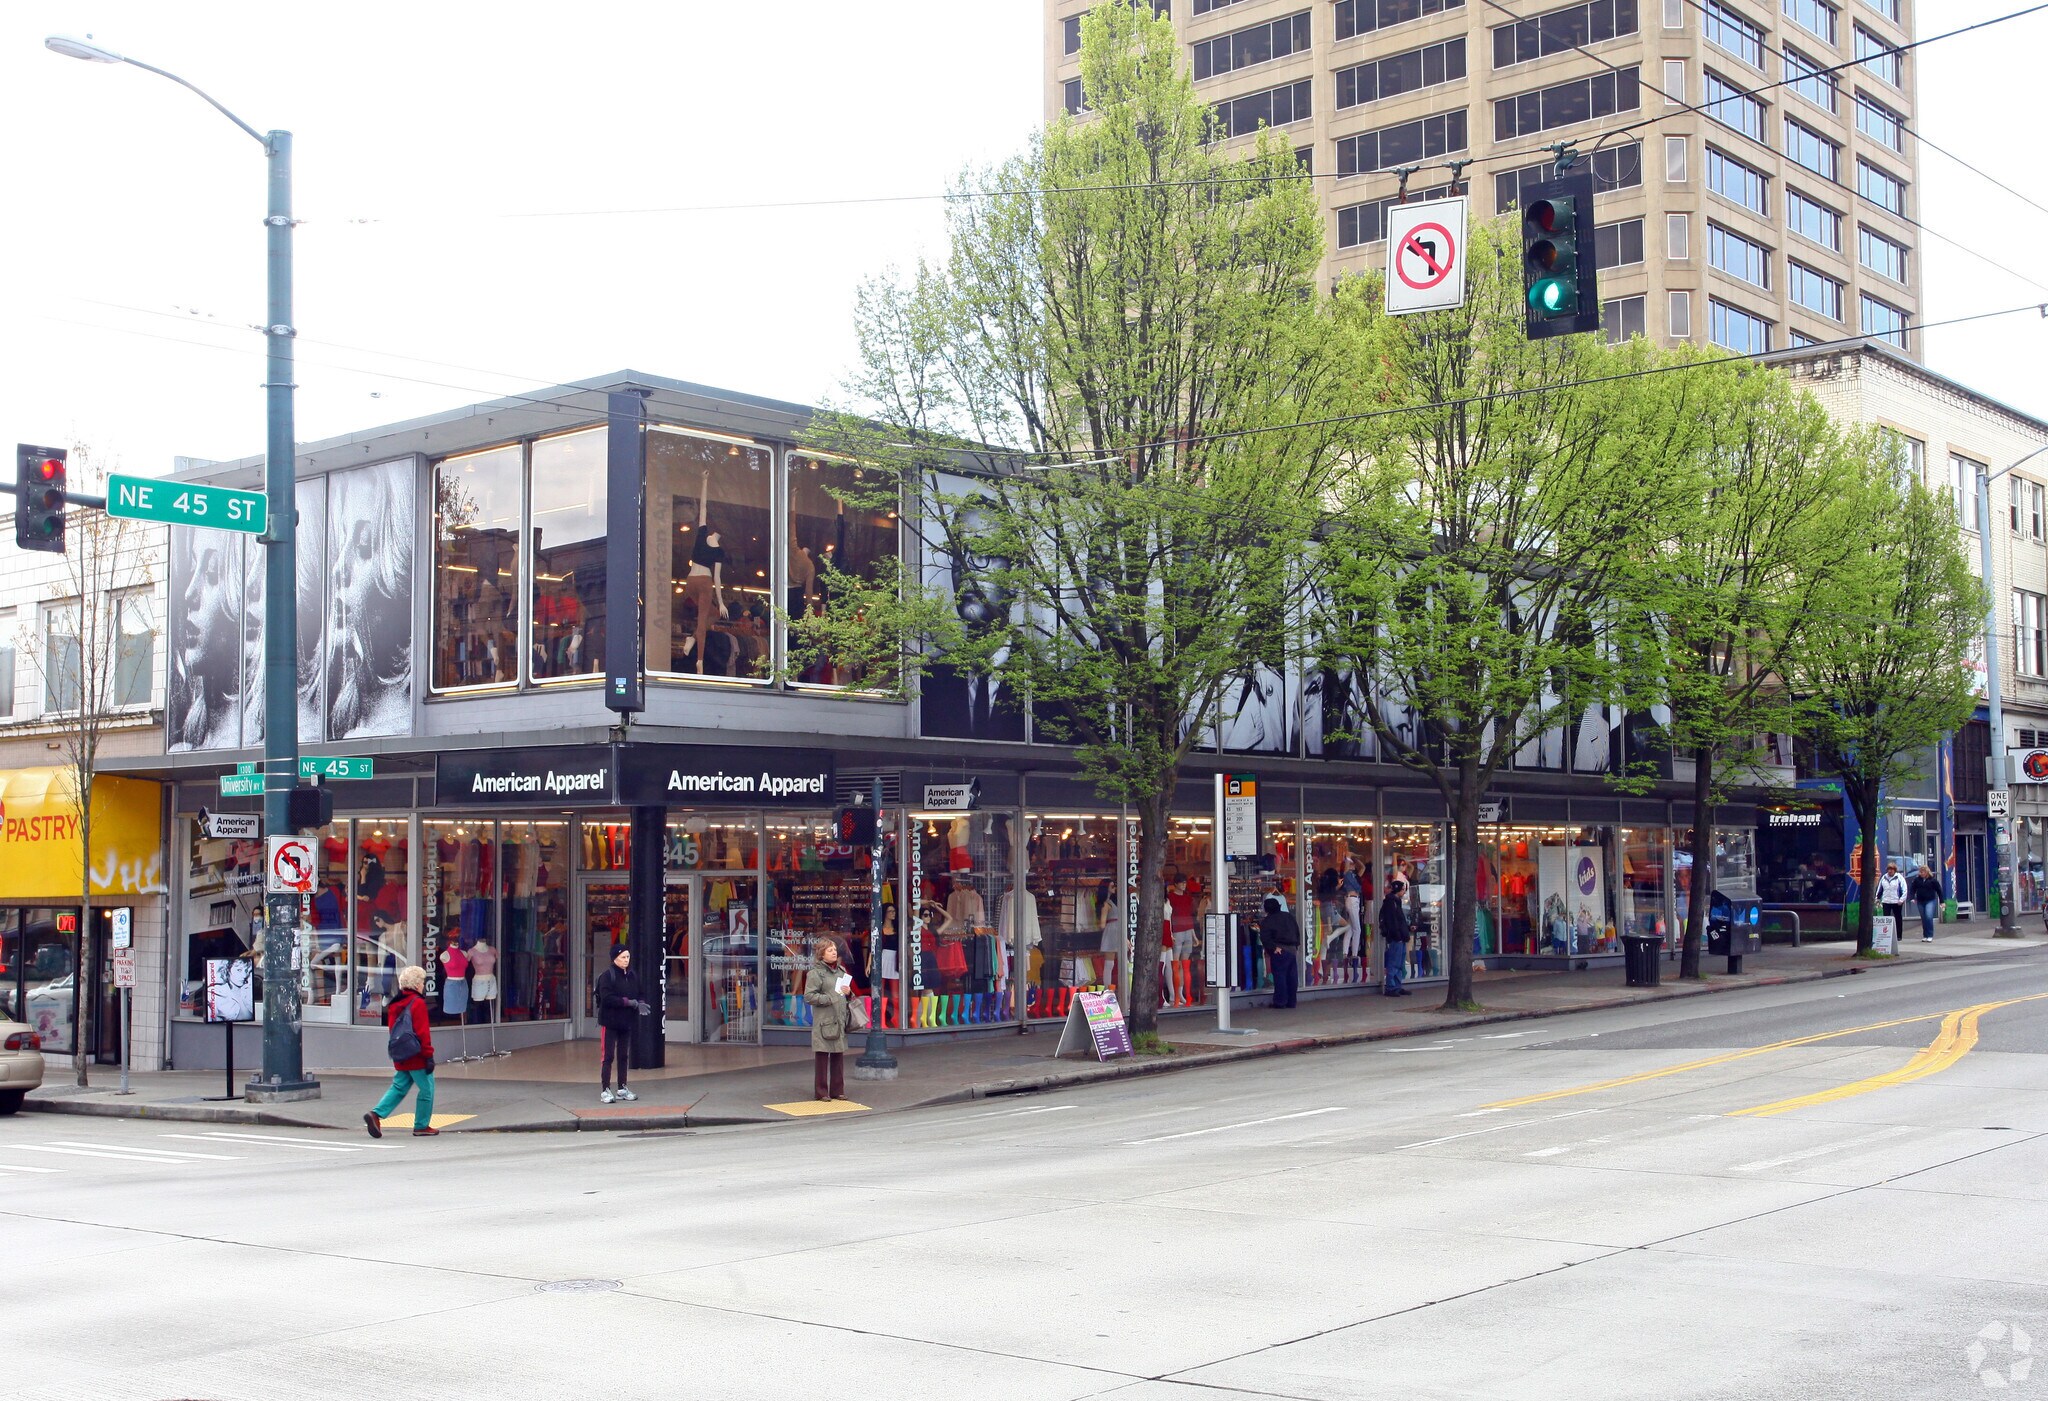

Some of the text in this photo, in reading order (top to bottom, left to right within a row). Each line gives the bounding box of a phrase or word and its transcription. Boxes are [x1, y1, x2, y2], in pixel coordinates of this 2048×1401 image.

[119, 483, 256, 521] NE 45 ST
[302, 760, 369, 776] NE 45 ST
[221, 776, 253, 793] University
[472, 772, 541, 793] American
[668, 770, 754, 792] American
[928, 788, 964, 796] American
[928, 797, 957, 807] Apparel
[6, 814, 79, 842] PASTRY
[216, 817, 256, 826] American
[1769, 813, 1821, 823] trabant
[216, 826, 248, 834] Apparel
[1128, 821, 1139, 888] Apparel
[1578, 867, 1595, 887] kids
[425, 829, 440, 997] American Apparel
[910, 817, 925, 990] American Apparel
[1305, 889, 1313, 965] American
